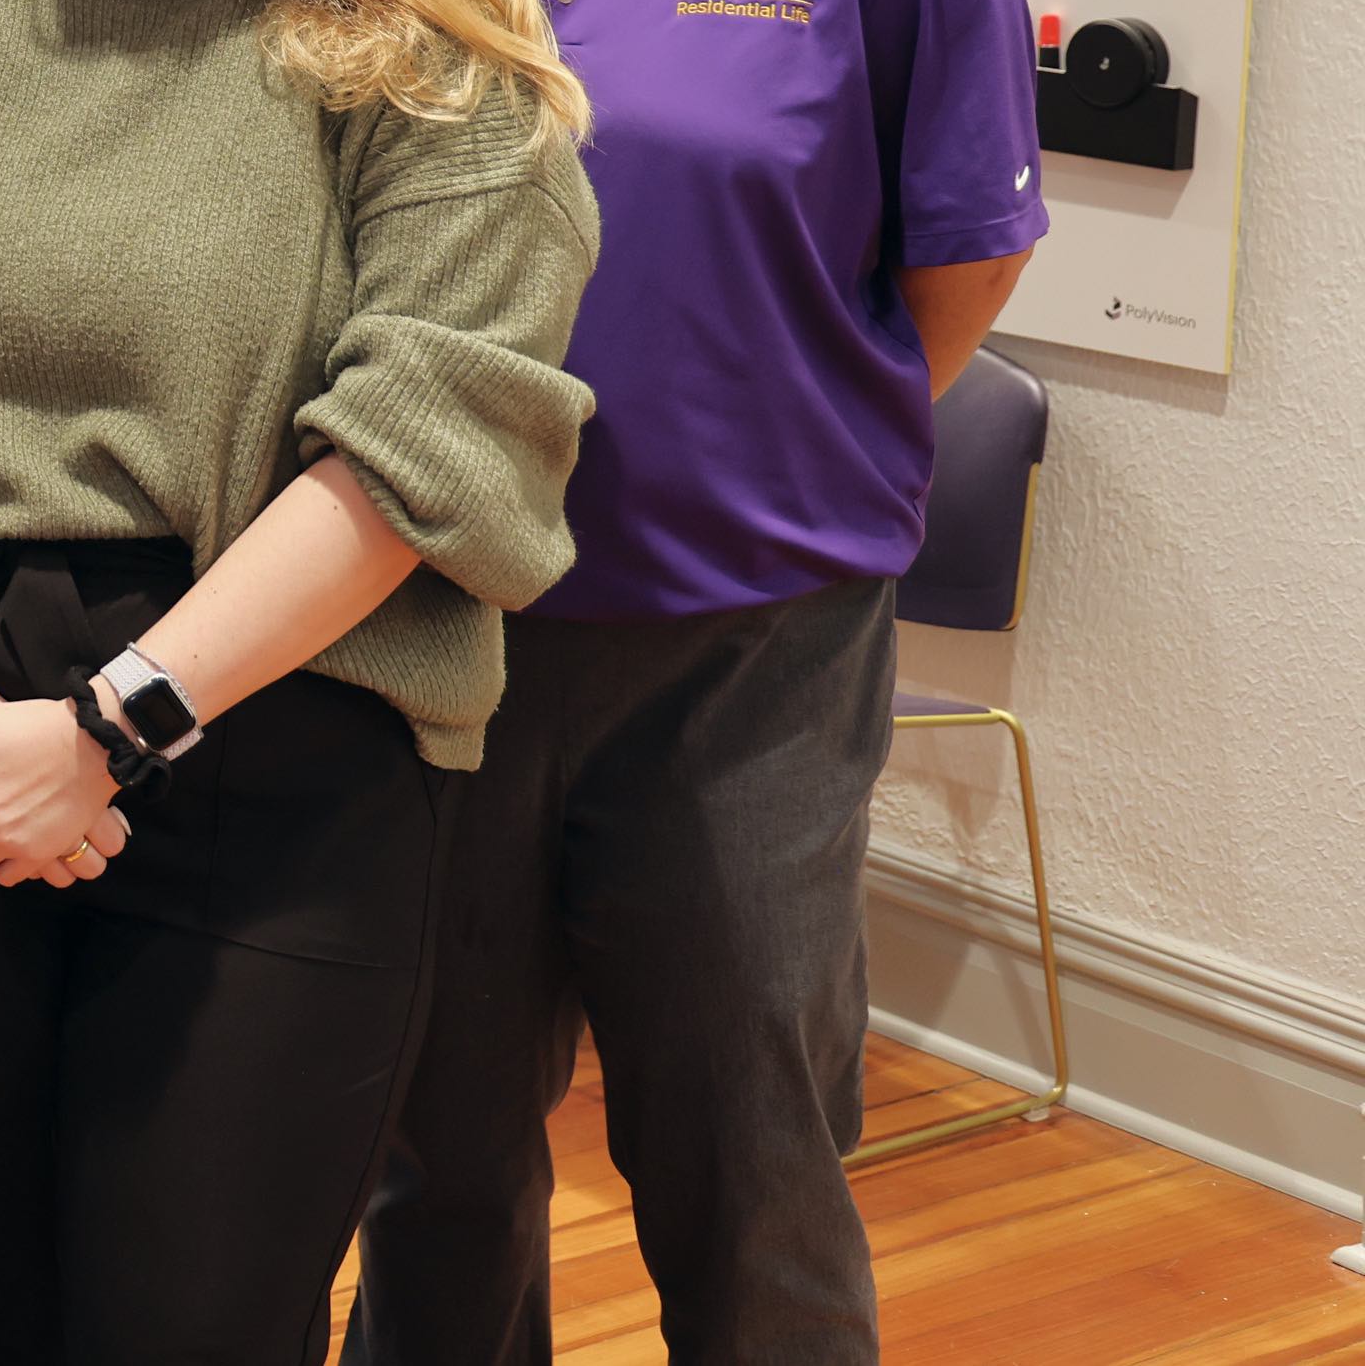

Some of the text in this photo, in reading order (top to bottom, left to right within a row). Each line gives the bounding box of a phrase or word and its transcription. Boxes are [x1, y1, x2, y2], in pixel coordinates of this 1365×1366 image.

[676, 0, 811, 25] Residential Life
[1125, 303, 1198, 330] PolyVision
